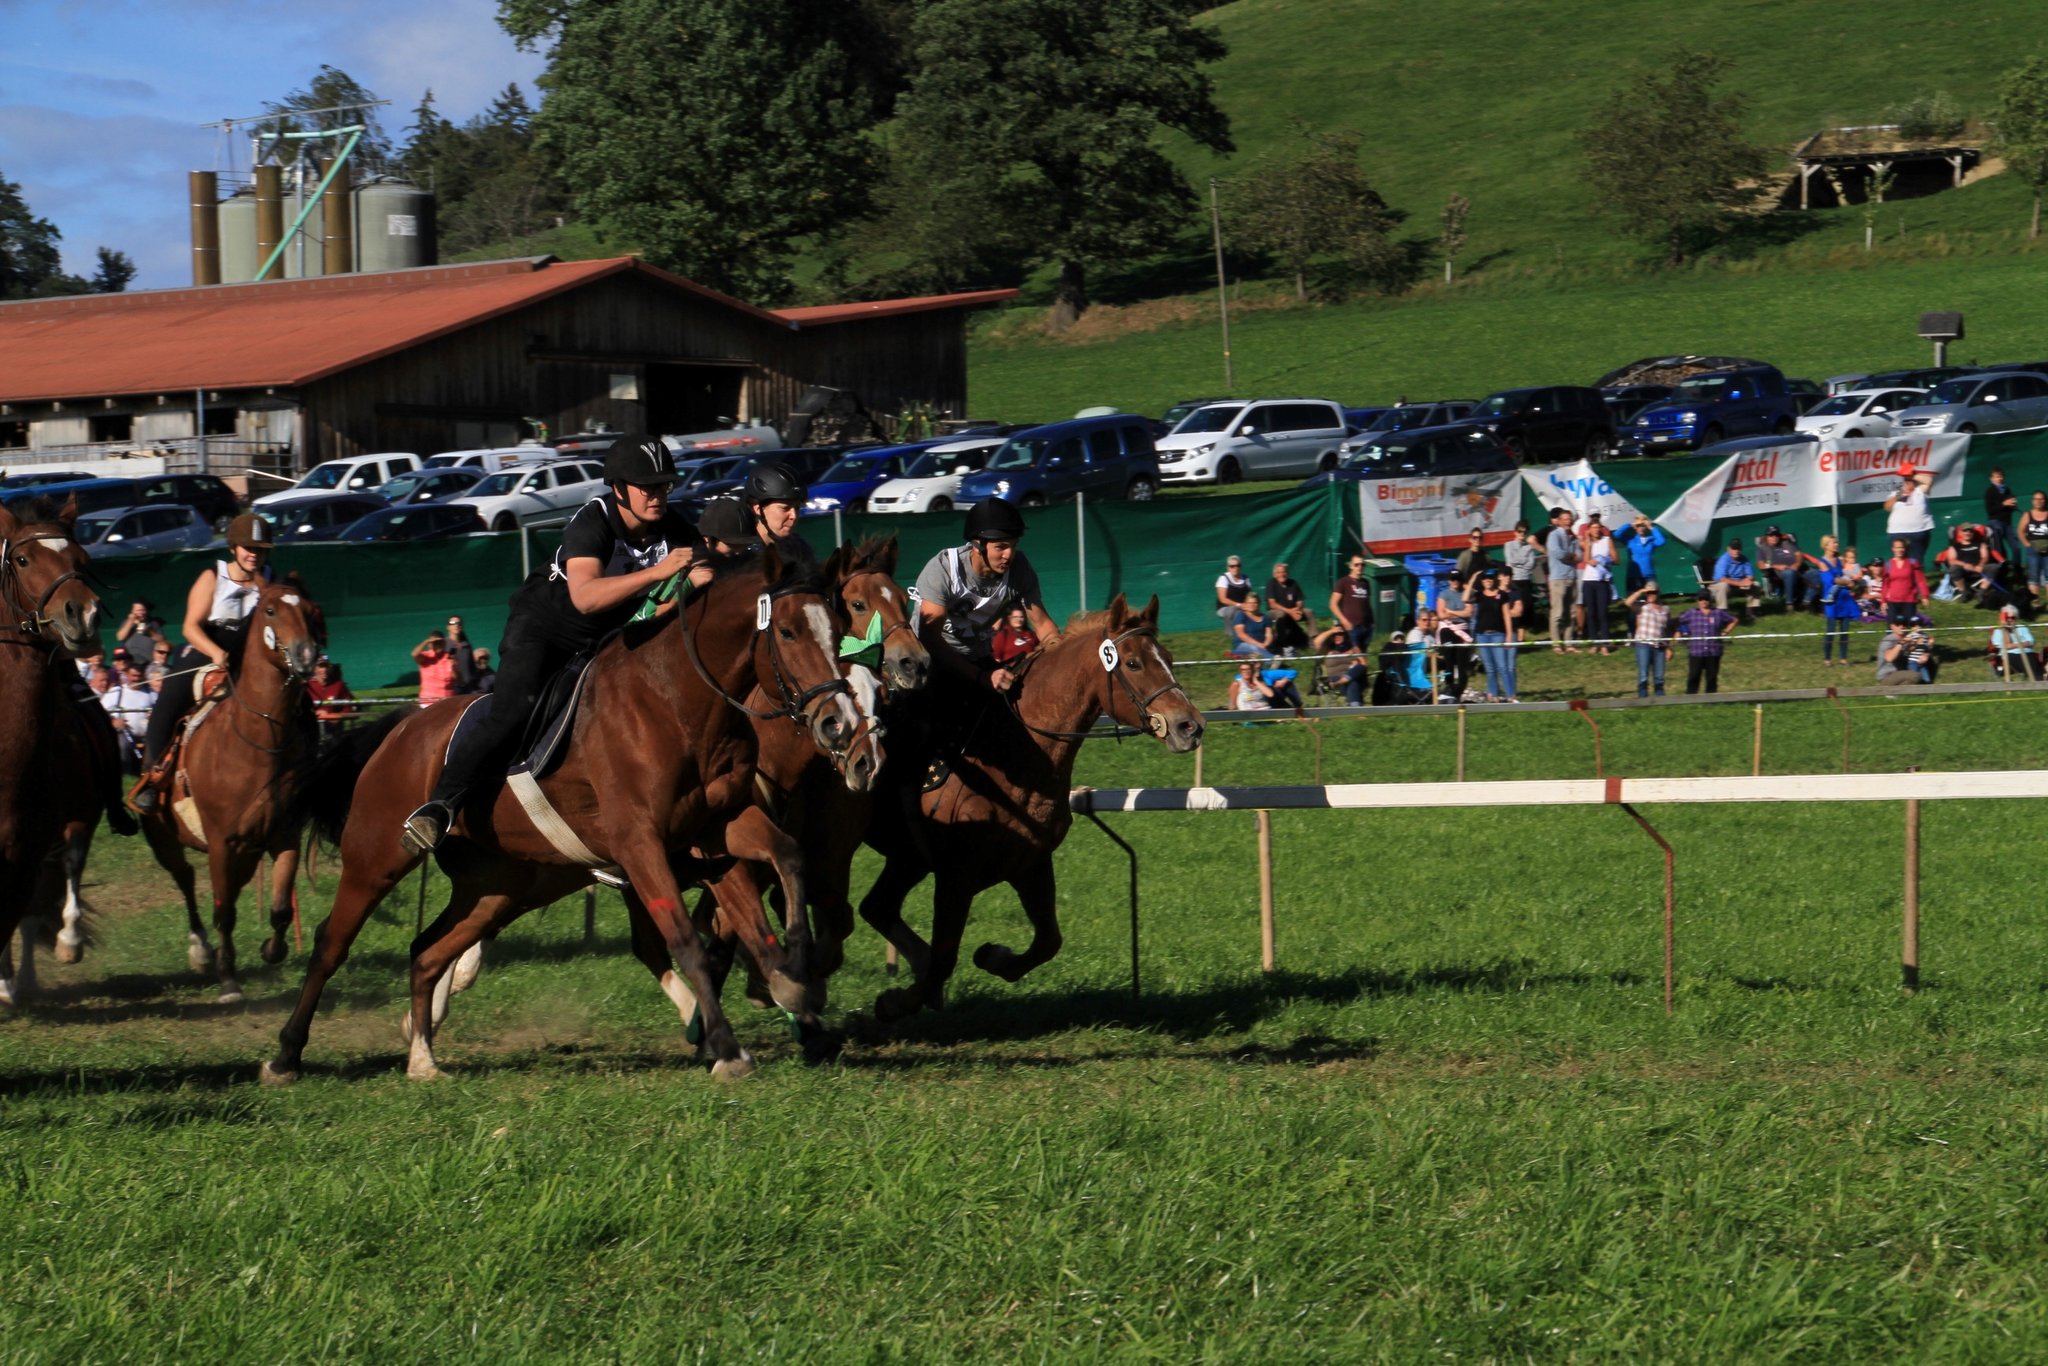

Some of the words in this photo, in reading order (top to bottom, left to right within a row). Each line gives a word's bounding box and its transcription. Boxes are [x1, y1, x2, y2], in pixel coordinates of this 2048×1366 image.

[1819, 439, 1934, 472] emmental
[1377, 482, 1445, 500] Bimont
[1103, 645, 1113, 665] 8
